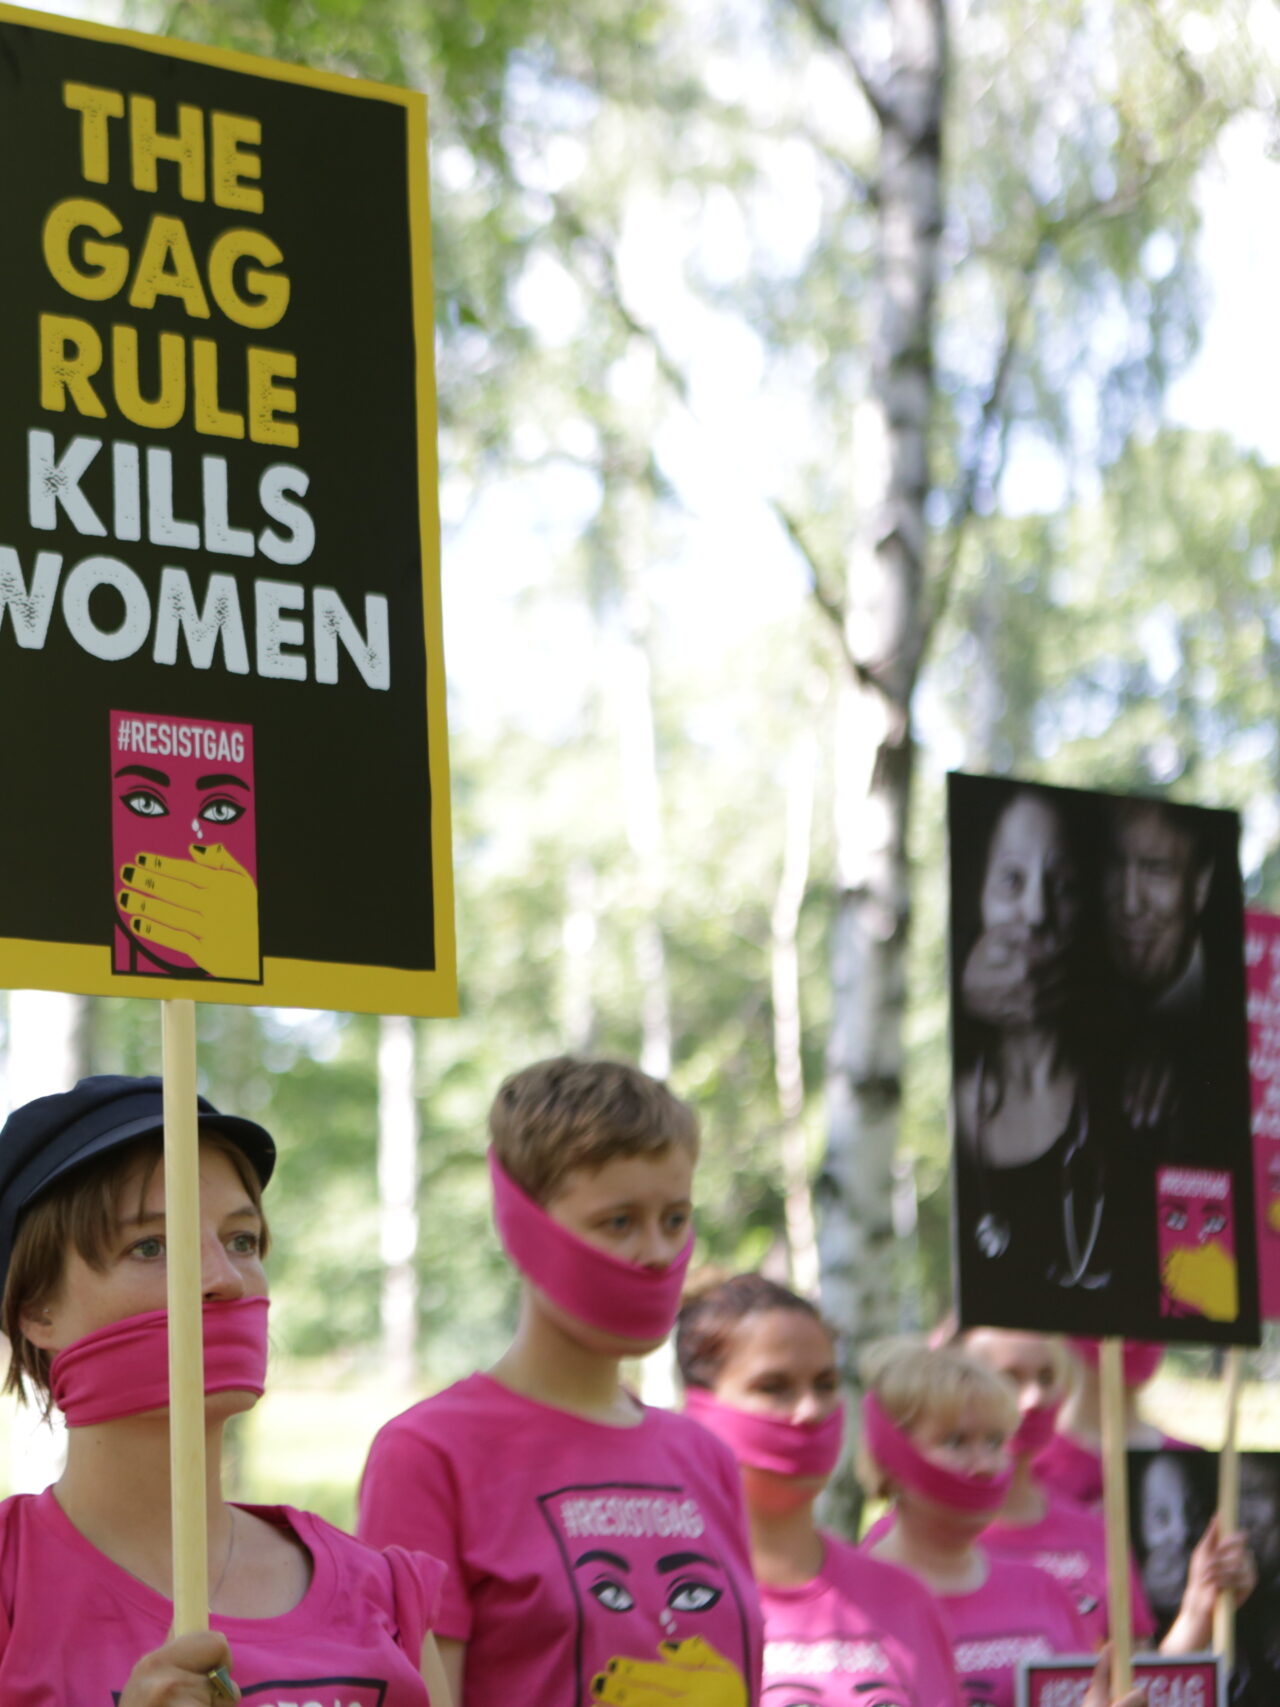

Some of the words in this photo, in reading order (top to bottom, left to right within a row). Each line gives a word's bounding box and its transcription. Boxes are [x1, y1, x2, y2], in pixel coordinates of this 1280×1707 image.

[63, 81, 263, 214] THE
[42, 197, 291, 330] GAG
[39, 312, 299, 448] RULE
[28, 429, 315, 566] KILLS
[117, 719, 245, 763] #RESISTGAG
